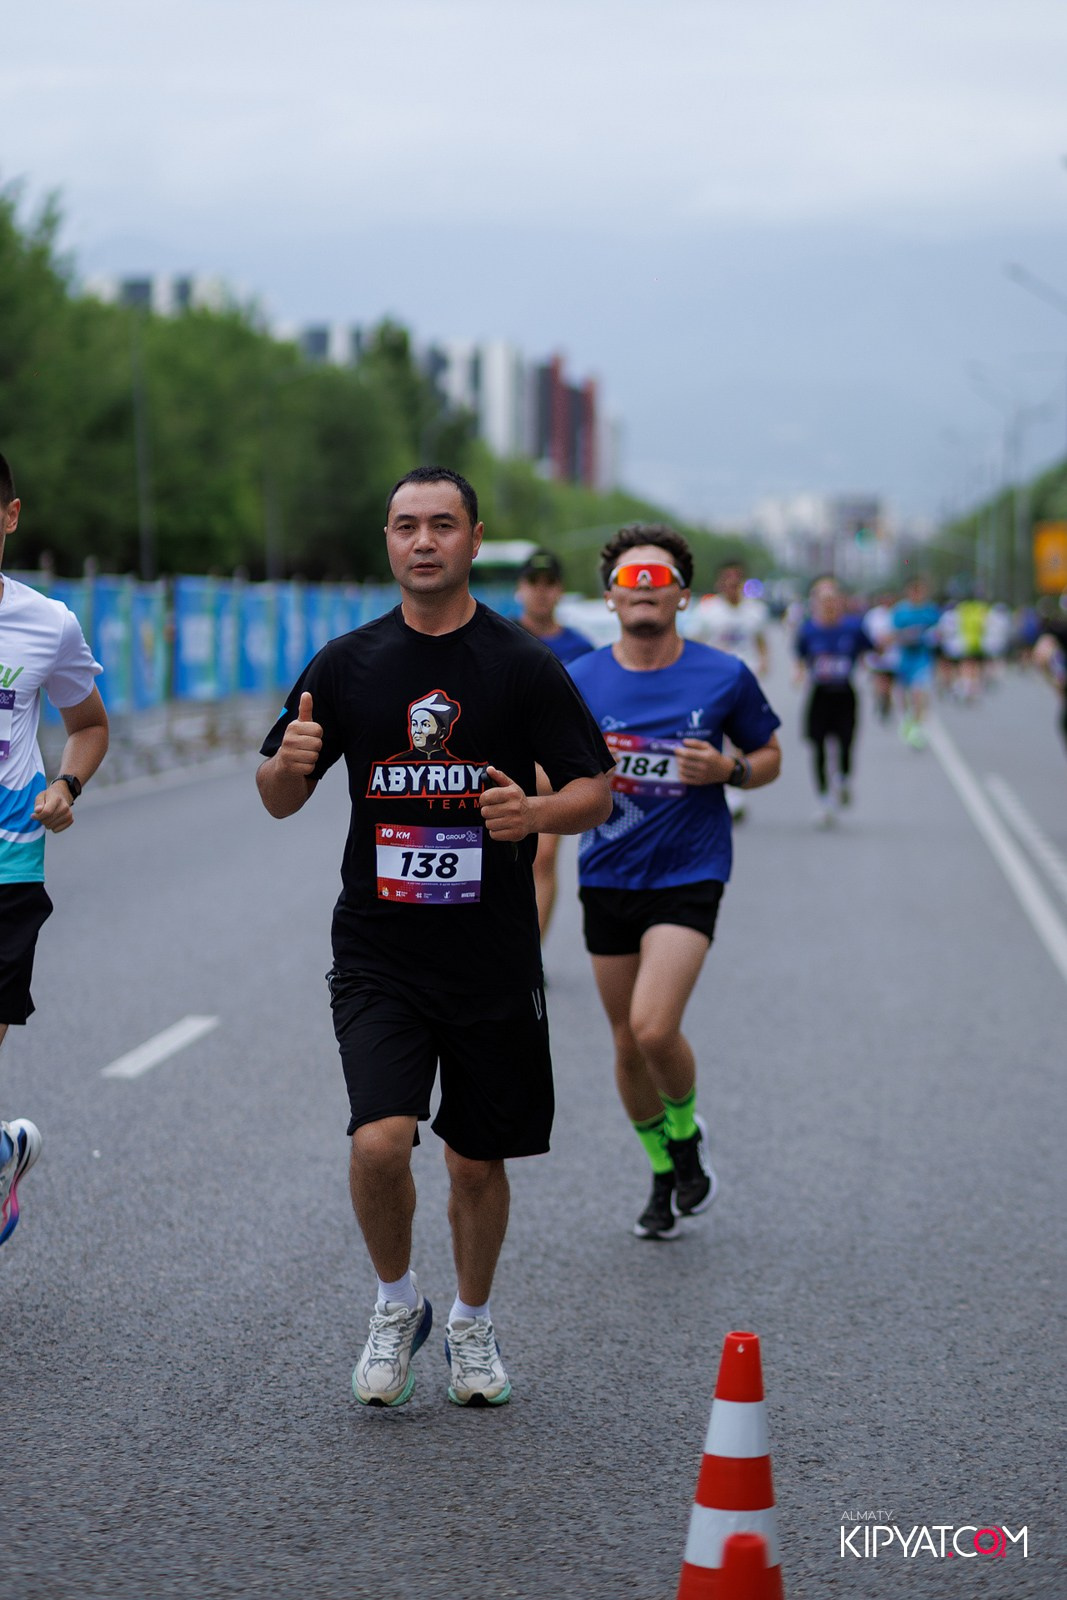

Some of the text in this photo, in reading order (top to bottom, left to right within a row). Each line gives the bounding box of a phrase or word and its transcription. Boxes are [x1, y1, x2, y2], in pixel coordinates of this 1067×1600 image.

[621, 755, 670, 778] 184
[371, 764, 484, 792] ABYROY
[427, 799, 481, 809] TEAM
[381, 828, 411, 840] 10 KM
[445, 833, 466, 841] GROUP
[400, 851, 459, 879] 138
